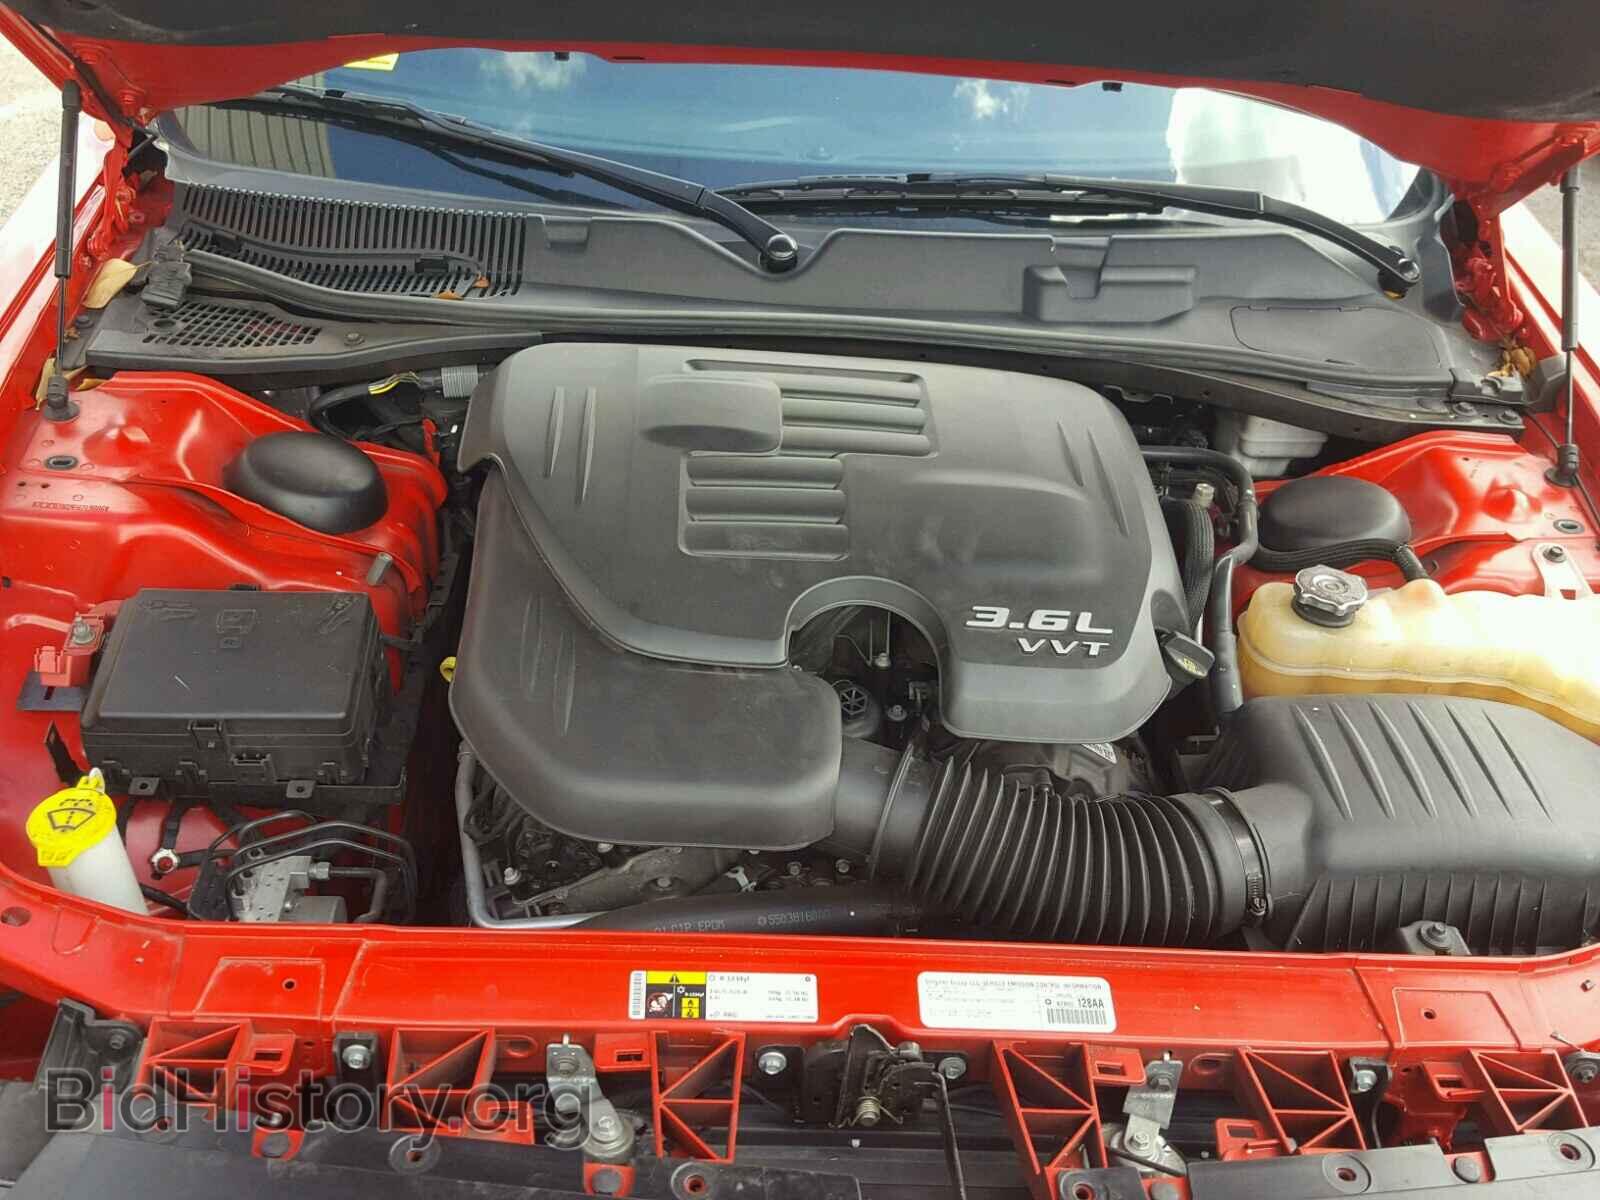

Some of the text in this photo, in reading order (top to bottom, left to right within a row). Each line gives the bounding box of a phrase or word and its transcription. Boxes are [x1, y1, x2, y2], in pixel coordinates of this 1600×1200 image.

[966, 605, 1113, 634] 3.6L
[1017, 637, 1110, 656] VVT
[1077, 997, 1105, 1008] 128AA
